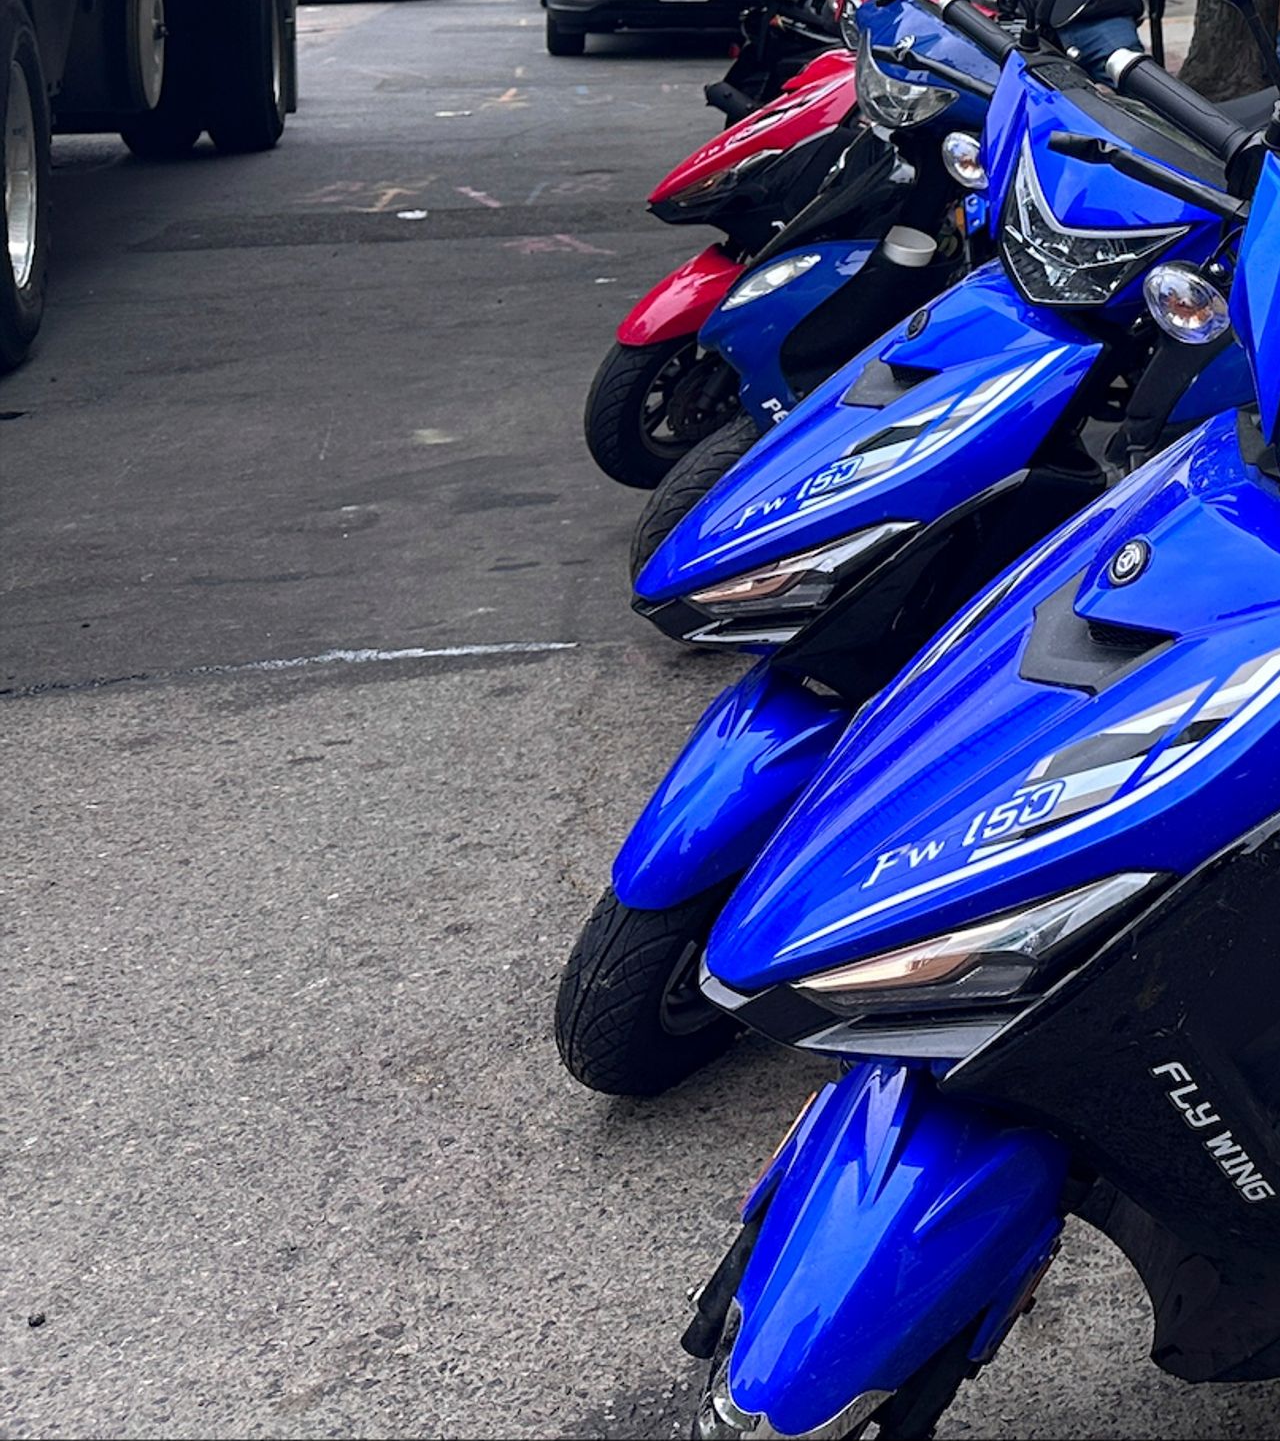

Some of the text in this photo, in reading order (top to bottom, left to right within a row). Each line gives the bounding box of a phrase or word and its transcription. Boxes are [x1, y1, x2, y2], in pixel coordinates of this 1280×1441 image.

[795, 455, 864, 500] 150
[961, 779, 1066, 848] 150
[1152, 1061, 1277, 1201] FLY WING
